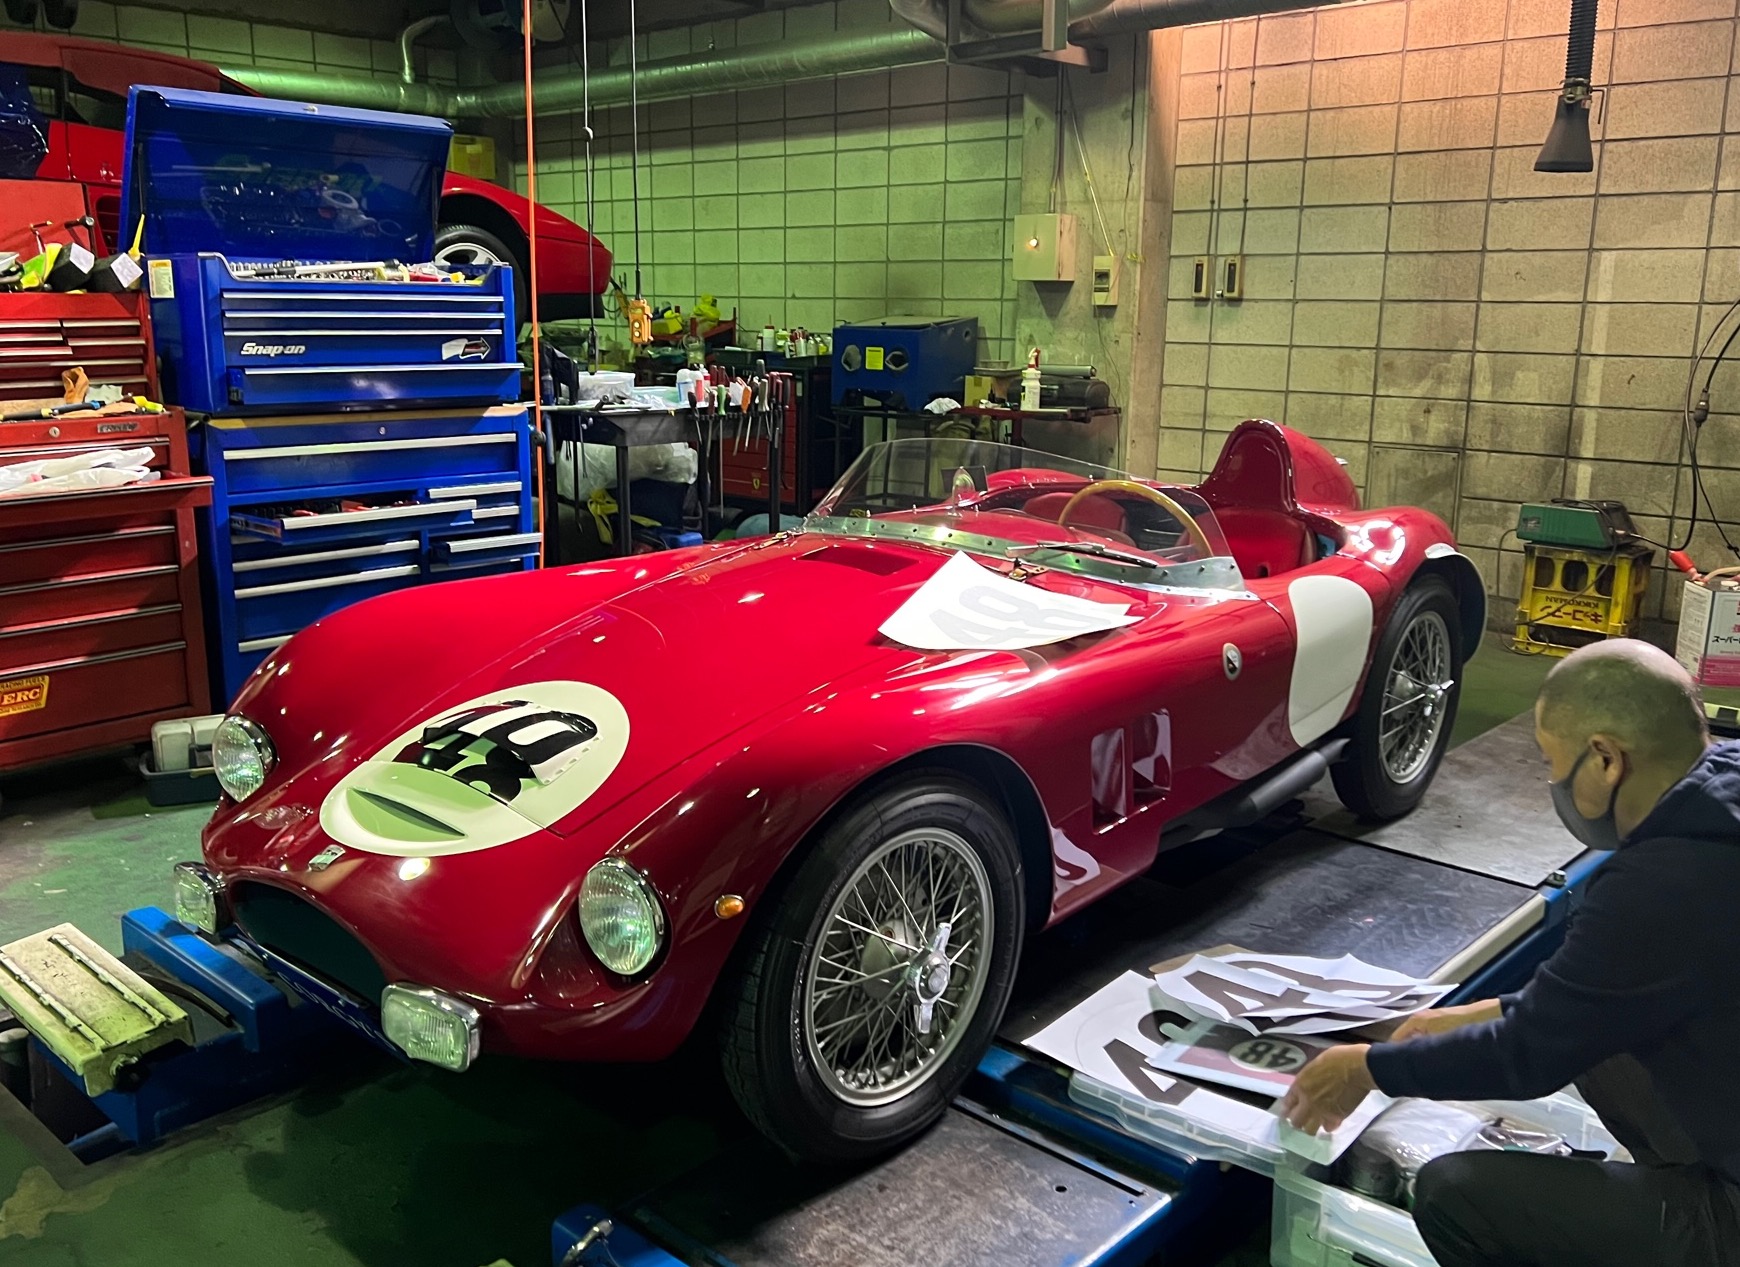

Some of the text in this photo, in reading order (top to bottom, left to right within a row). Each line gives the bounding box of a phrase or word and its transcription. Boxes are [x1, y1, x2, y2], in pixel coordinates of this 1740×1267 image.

[241, 342, 306, 357] Snap-on
[2, 688, 40, 705] ERC
[1239, 1041, 1298, 1069] 48
